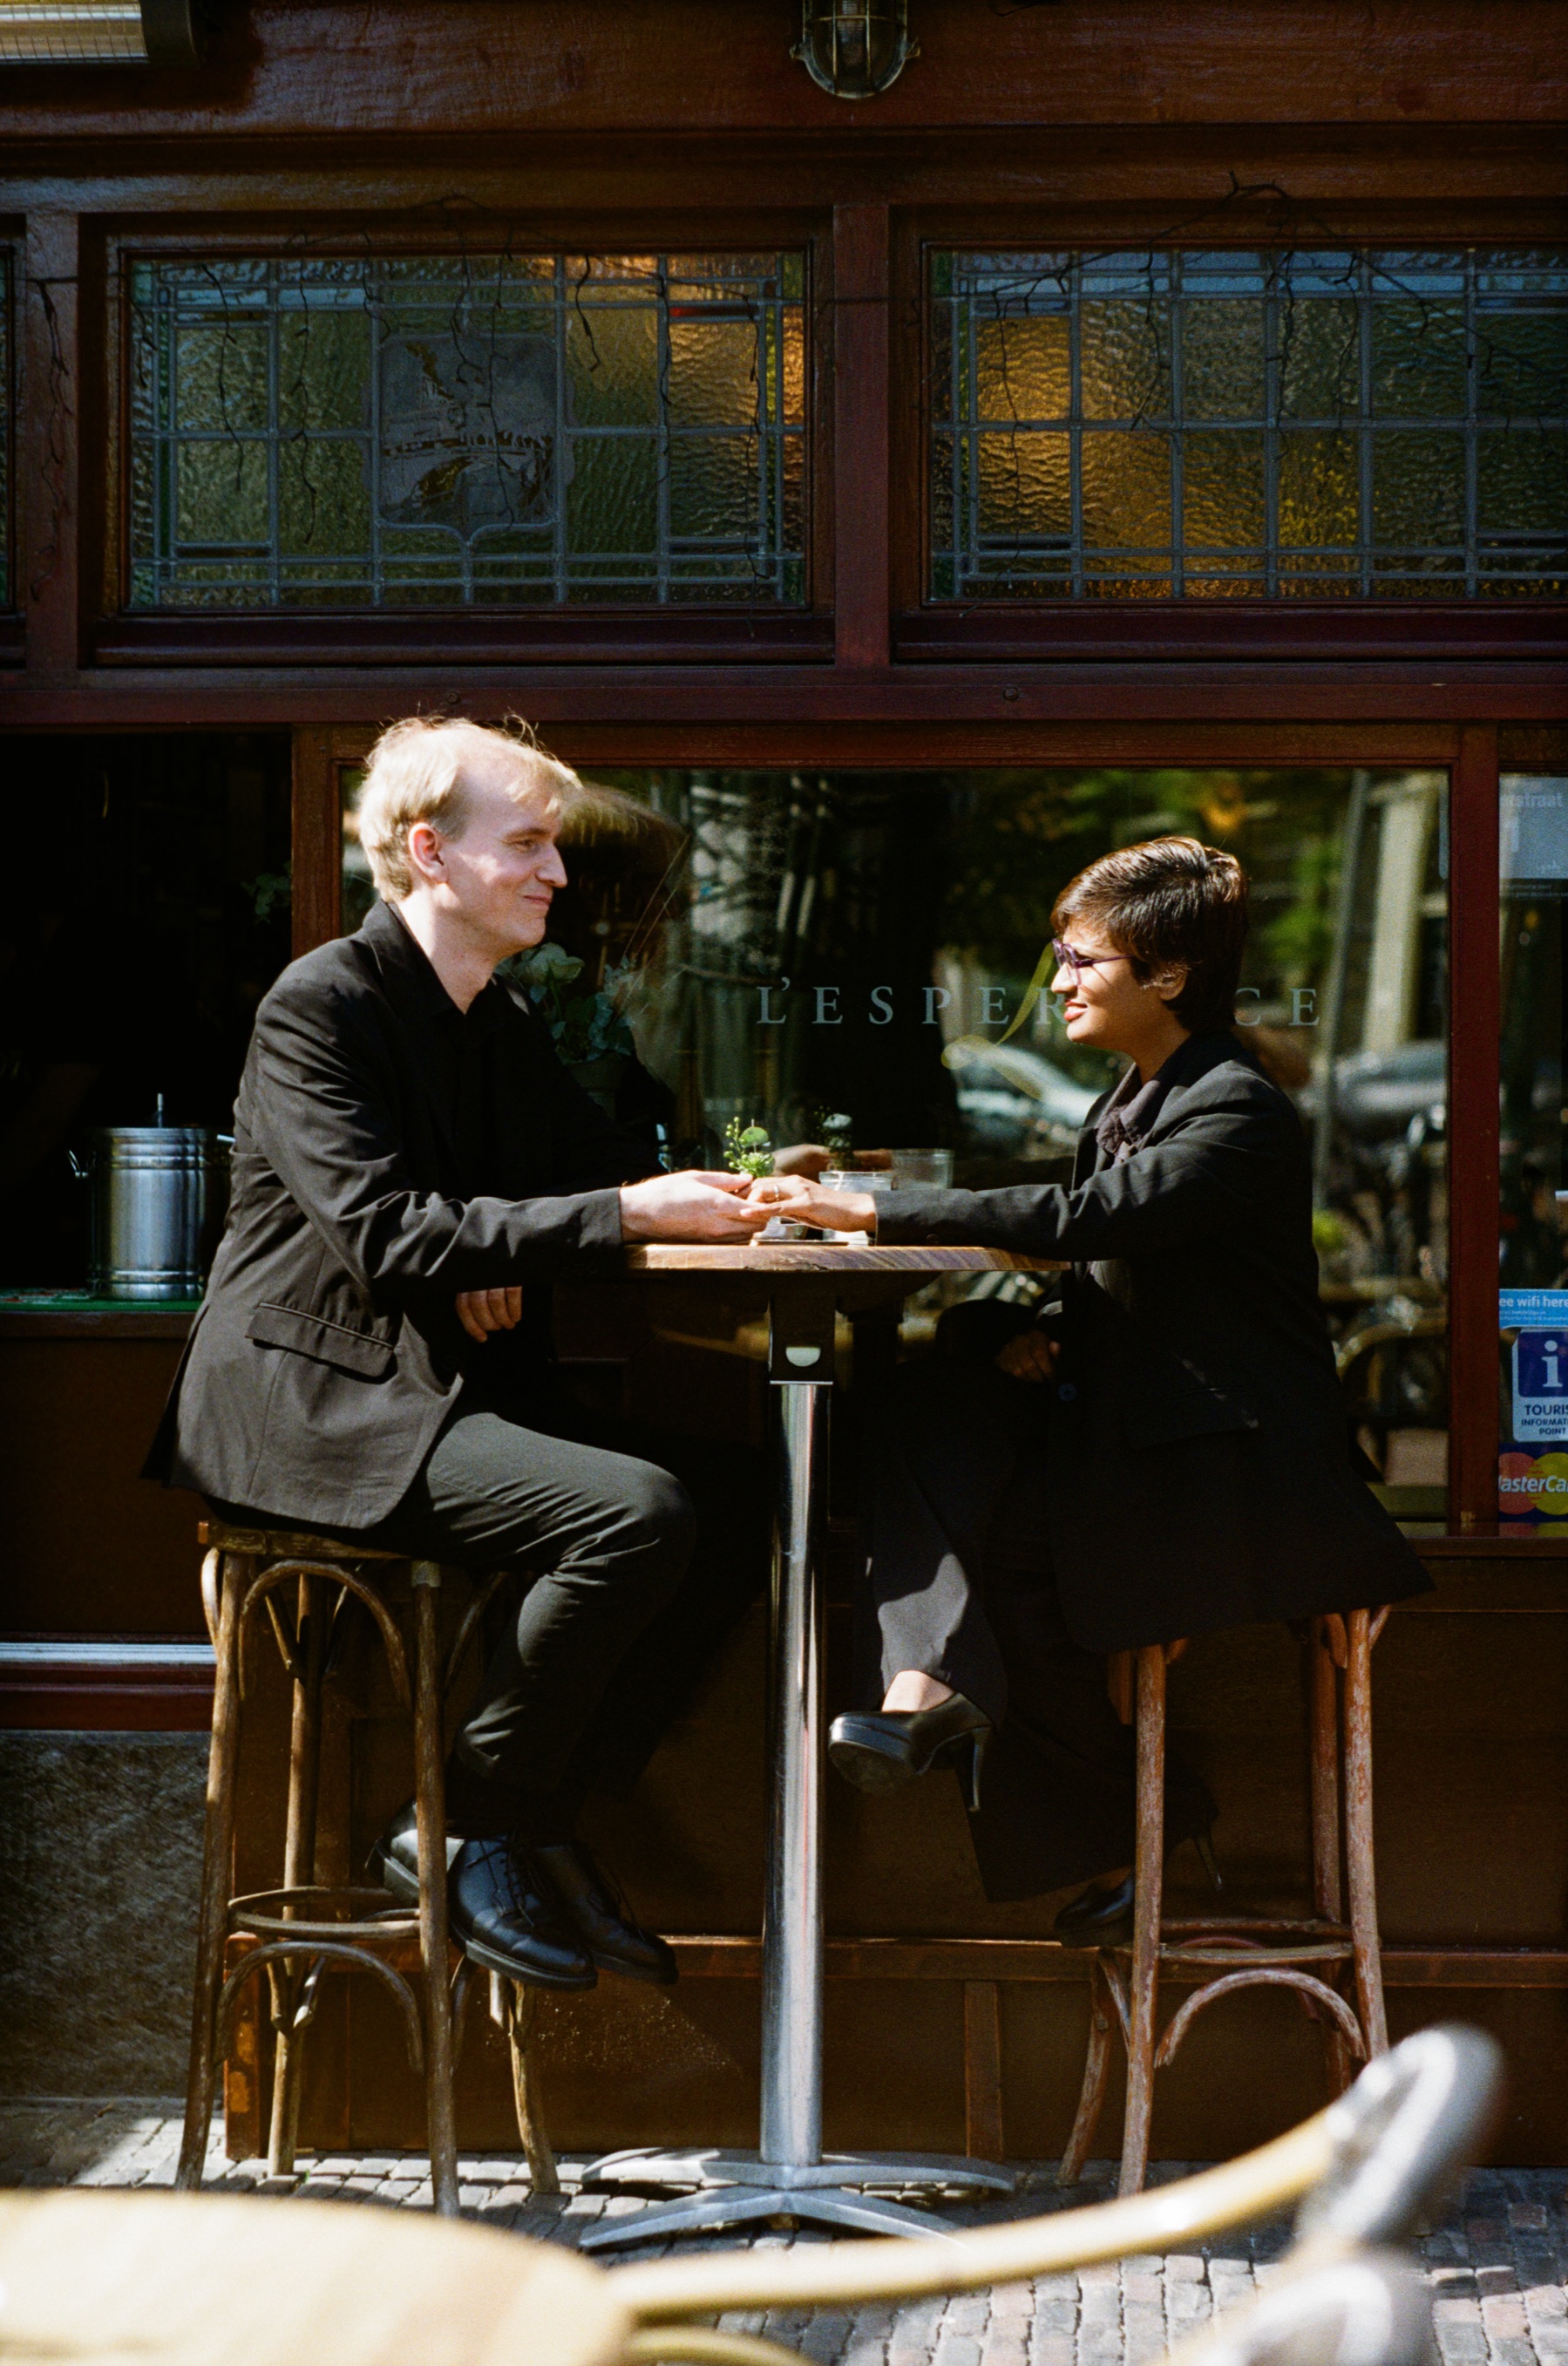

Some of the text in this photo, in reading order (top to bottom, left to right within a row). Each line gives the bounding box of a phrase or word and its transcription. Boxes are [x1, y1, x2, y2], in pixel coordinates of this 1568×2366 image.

[756, 976, 1320, 1027] L'ESPERCE
[1517, 1295, 1540, 1308] wifi
[1539, 1427, 1566, 1436] POINT
